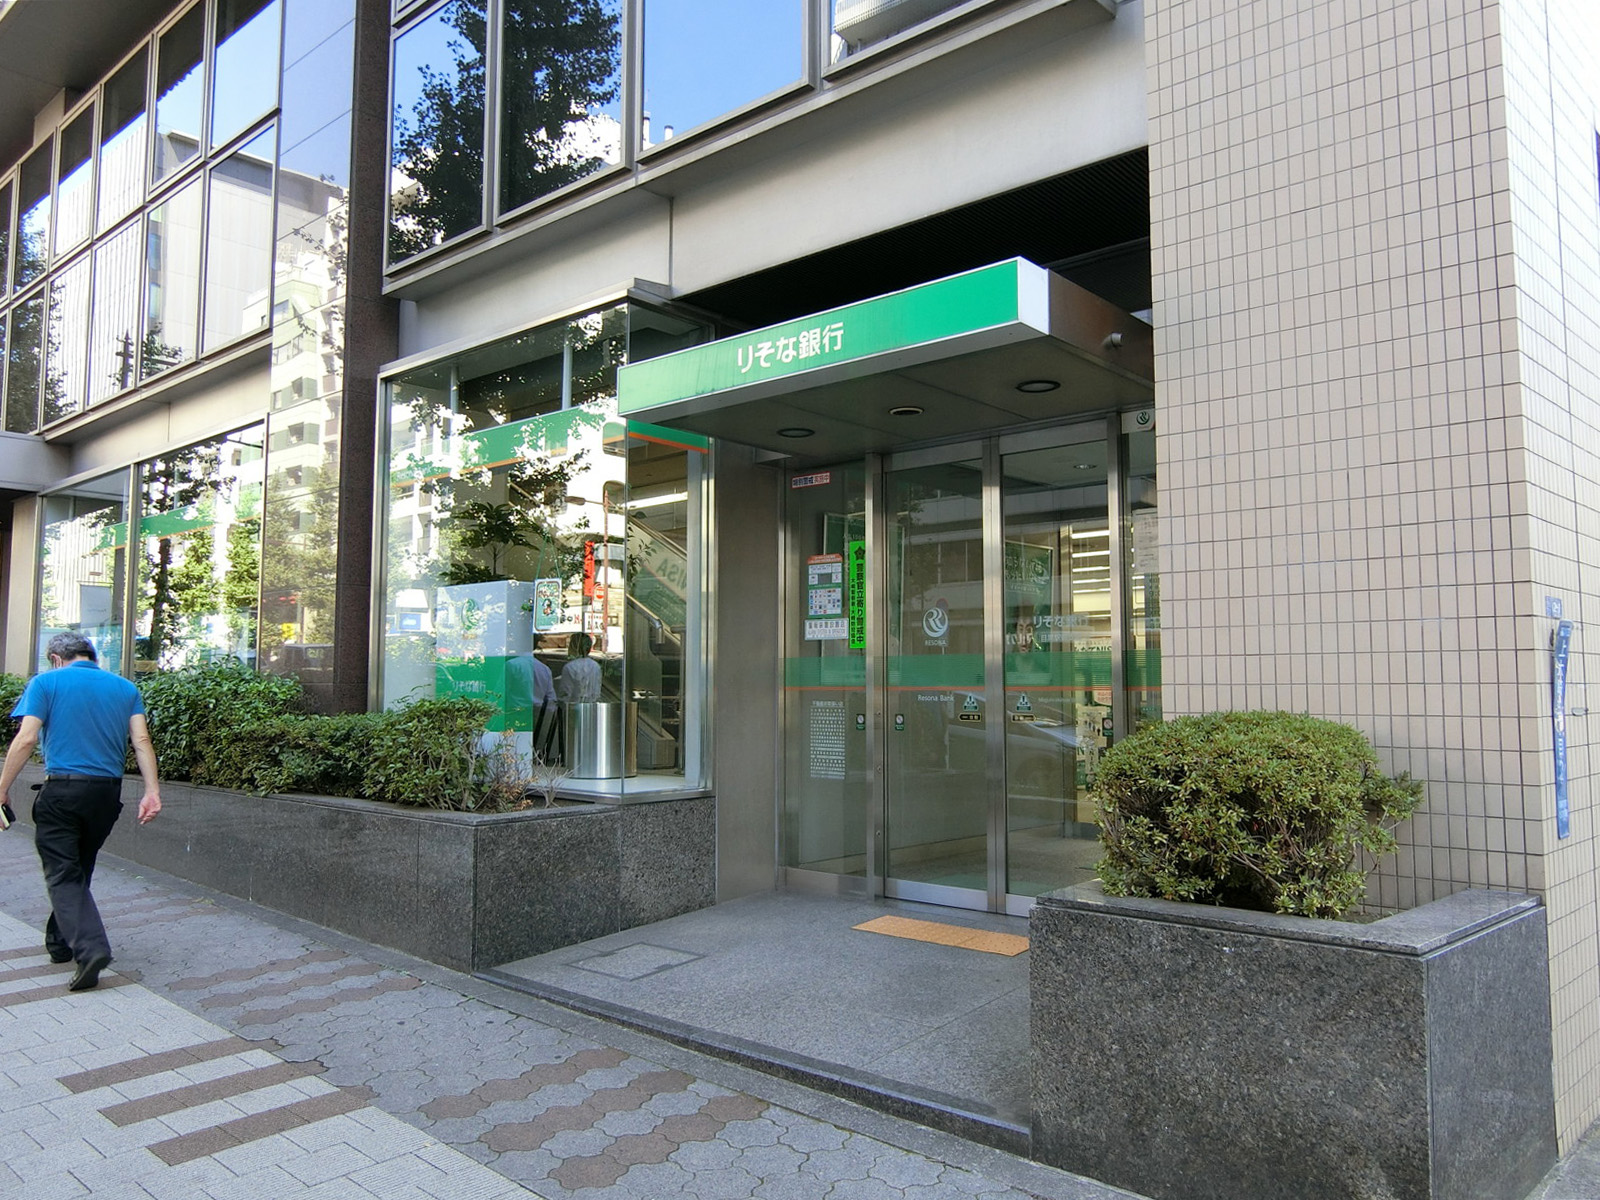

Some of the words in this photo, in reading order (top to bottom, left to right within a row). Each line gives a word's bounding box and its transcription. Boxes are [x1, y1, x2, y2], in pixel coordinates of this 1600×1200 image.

[736, 322, 845, 374] りそな銀行
[917, 694, 939, 702] Resona
[940, 694, 955, 702] Bank
